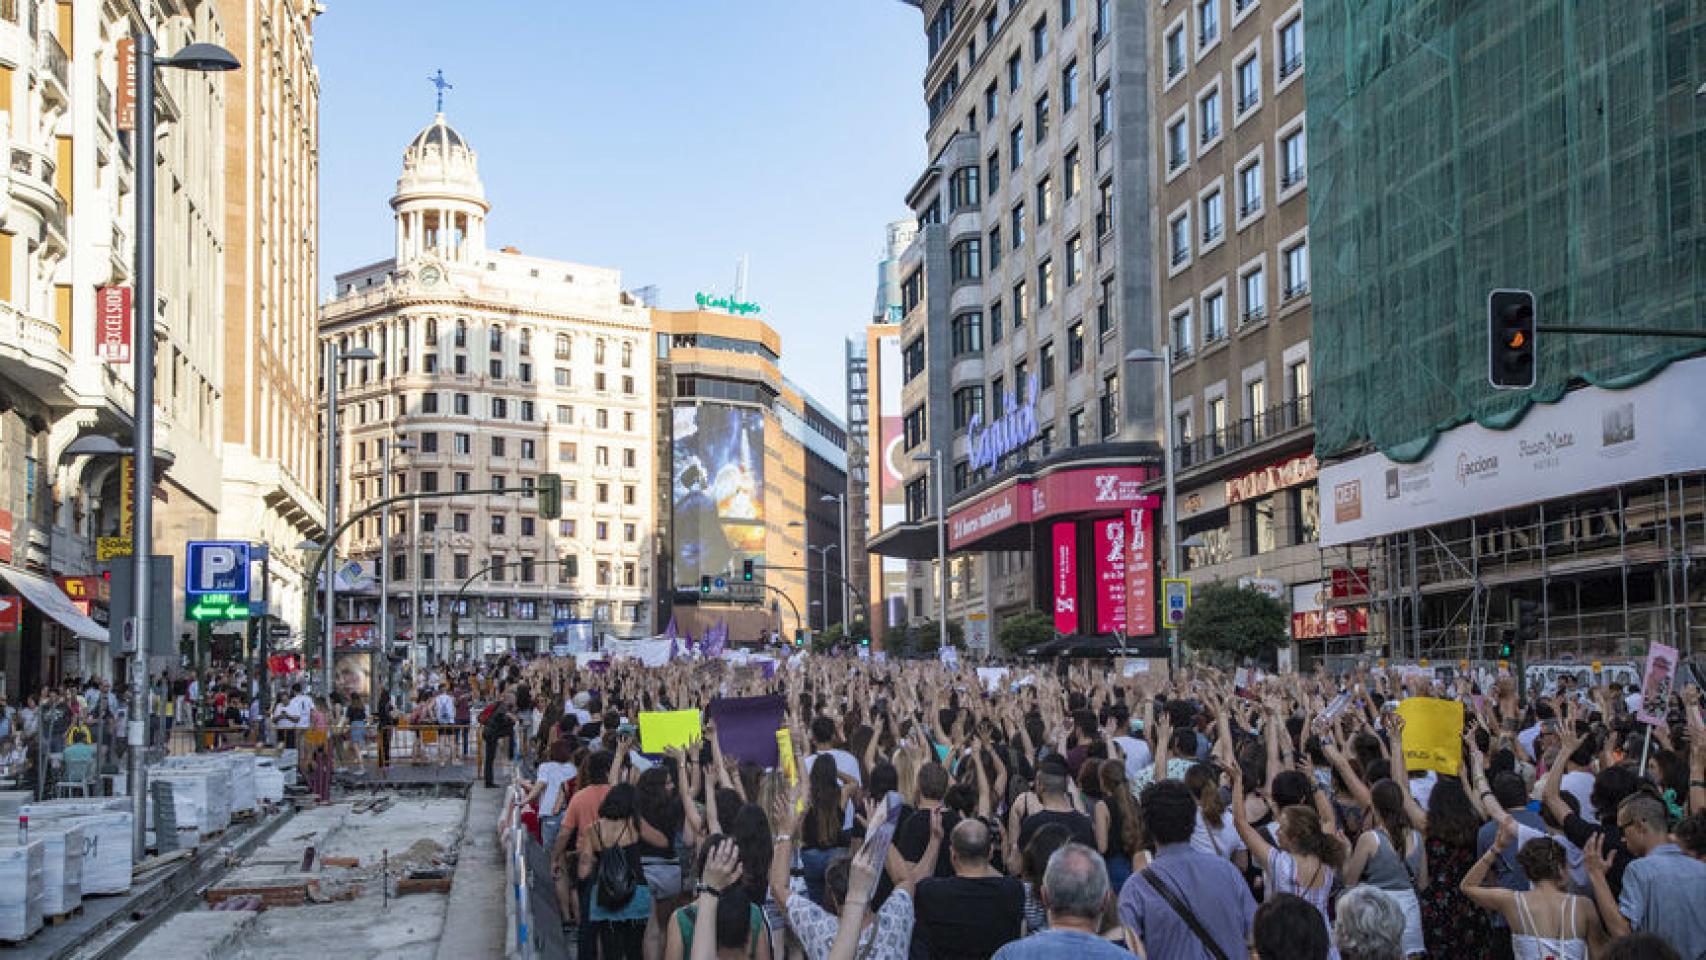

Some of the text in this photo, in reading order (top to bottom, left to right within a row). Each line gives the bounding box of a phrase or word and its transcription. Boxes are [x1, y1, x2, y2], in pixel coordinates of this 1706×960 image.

[967, 373, 1039, 475] Capitol
[201, 547, 235, 589] P
[202, 593, 230, 605] LIBRE
